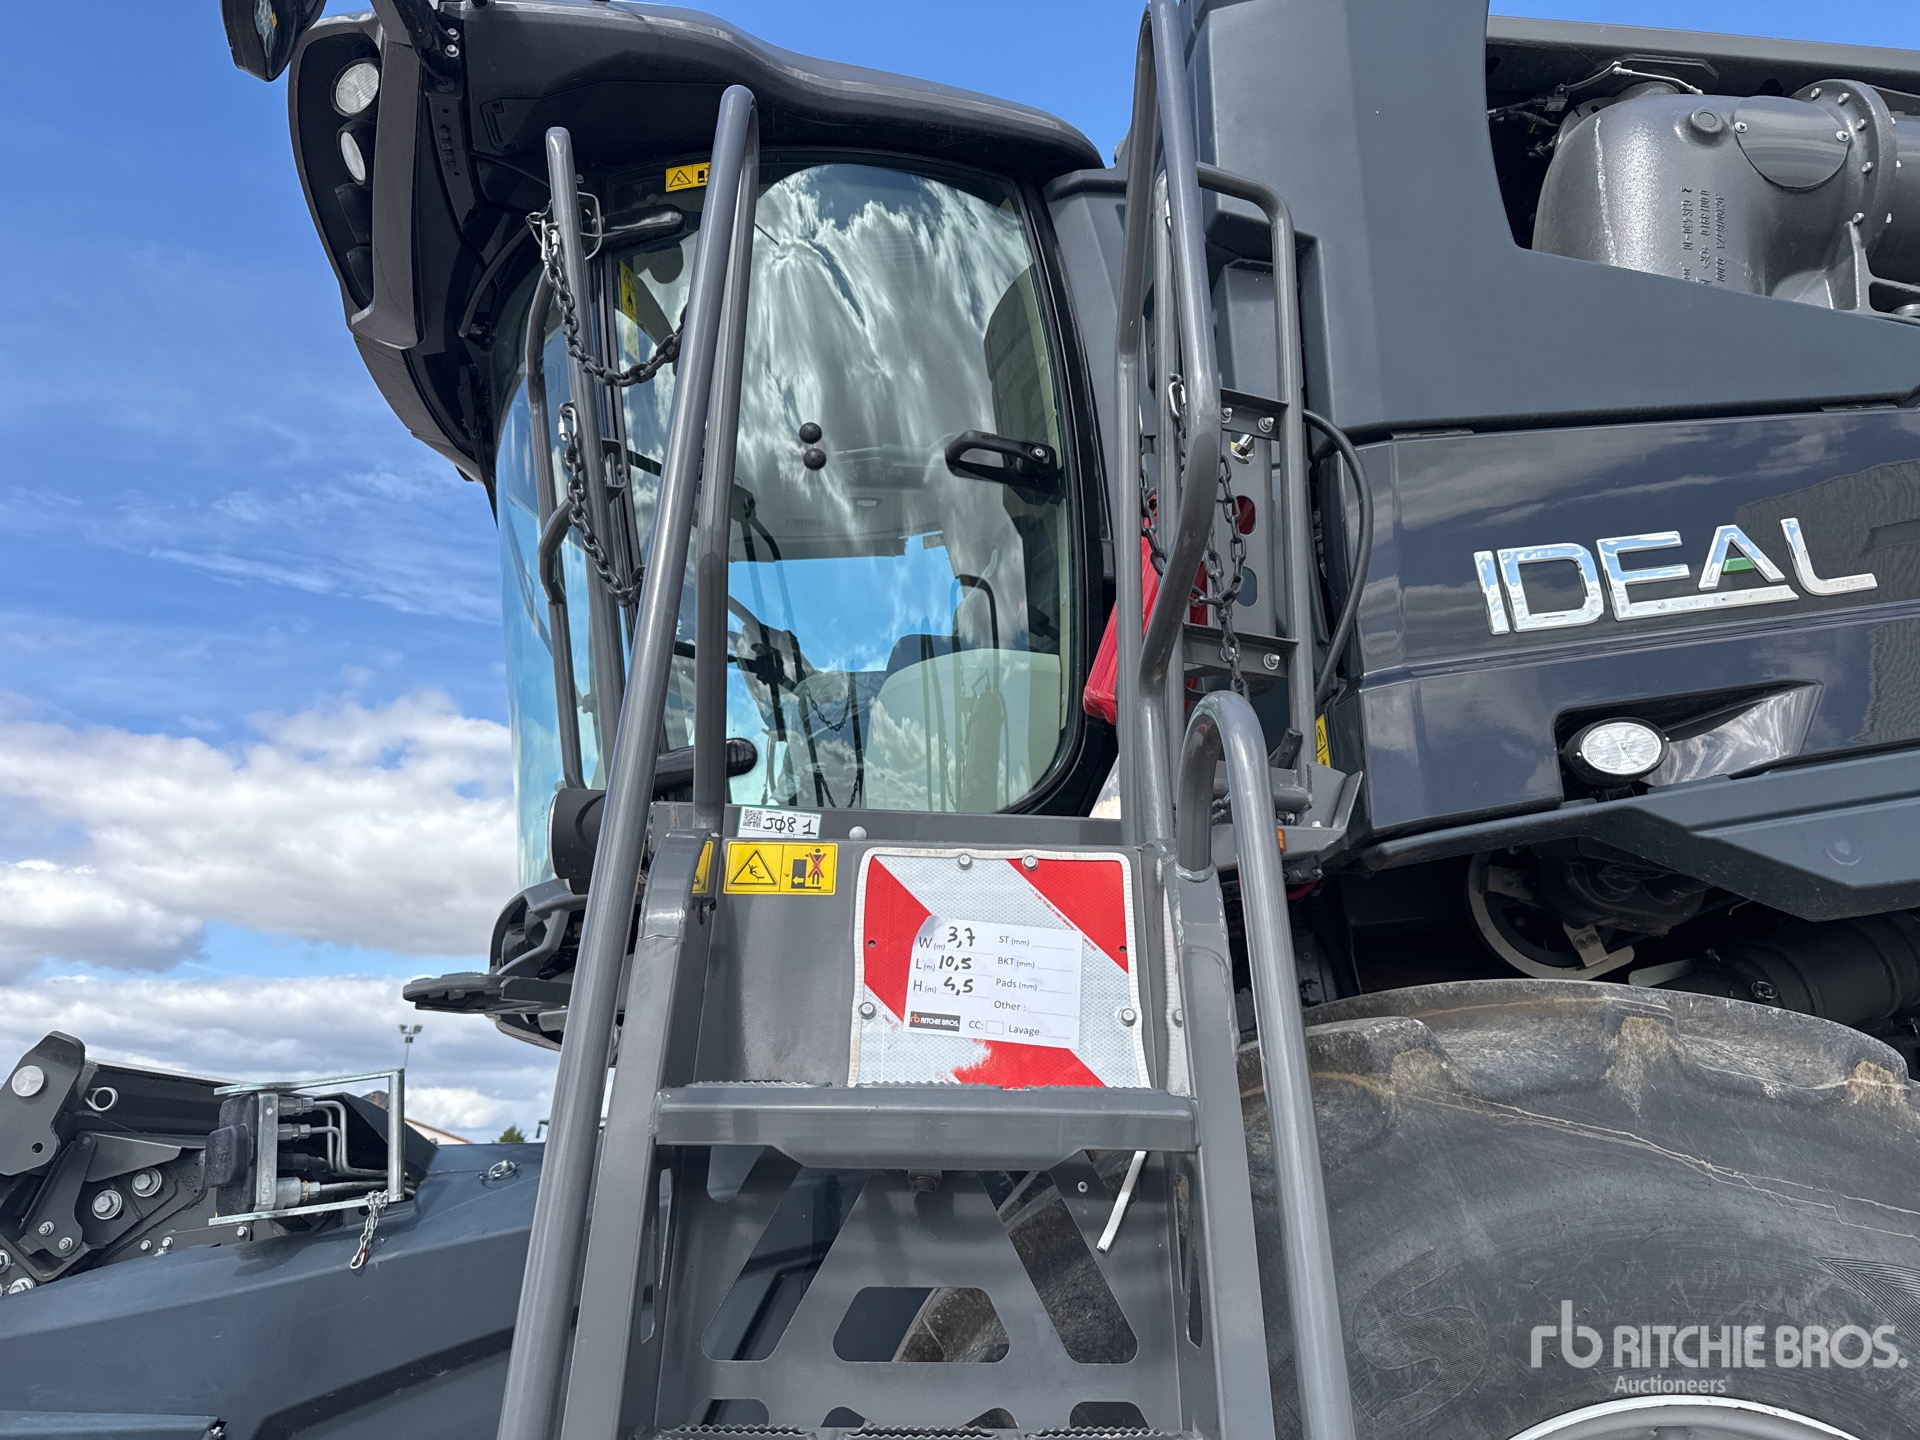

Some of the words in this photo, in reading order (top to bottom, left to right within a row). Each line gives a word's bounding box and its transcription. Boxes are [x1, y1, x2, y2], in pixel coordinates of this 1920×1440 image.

[1473, 517, 1878, 635] IDEAL
[919, 936, 933, 948] W
[934, 943, 946, 951] (m)
[947, 926, 976, 948] 3,7
[998, 935, 1010, 944] ST
[1011, 938, 1030, 947] (mm)
[915, 958, 922, 969] L
[923, 963, 936, 972] (m)
[939, 955, 972, 971] 10,5
[997, 956, 1015, 966] BKT
[1016, 960, 1035, 969] (mm)
[913, 979, 923, 991] H
[924, 985, 937, 994] (m)
[996, 978, 1017, 988] Pads
[1018, 981, 1038, 991] (mm)
[994, 1000, 1021, 1010] Other
[920, 1016, 942, 1026] RITCHIE
[968, 1020, 984, 1030] CC:
